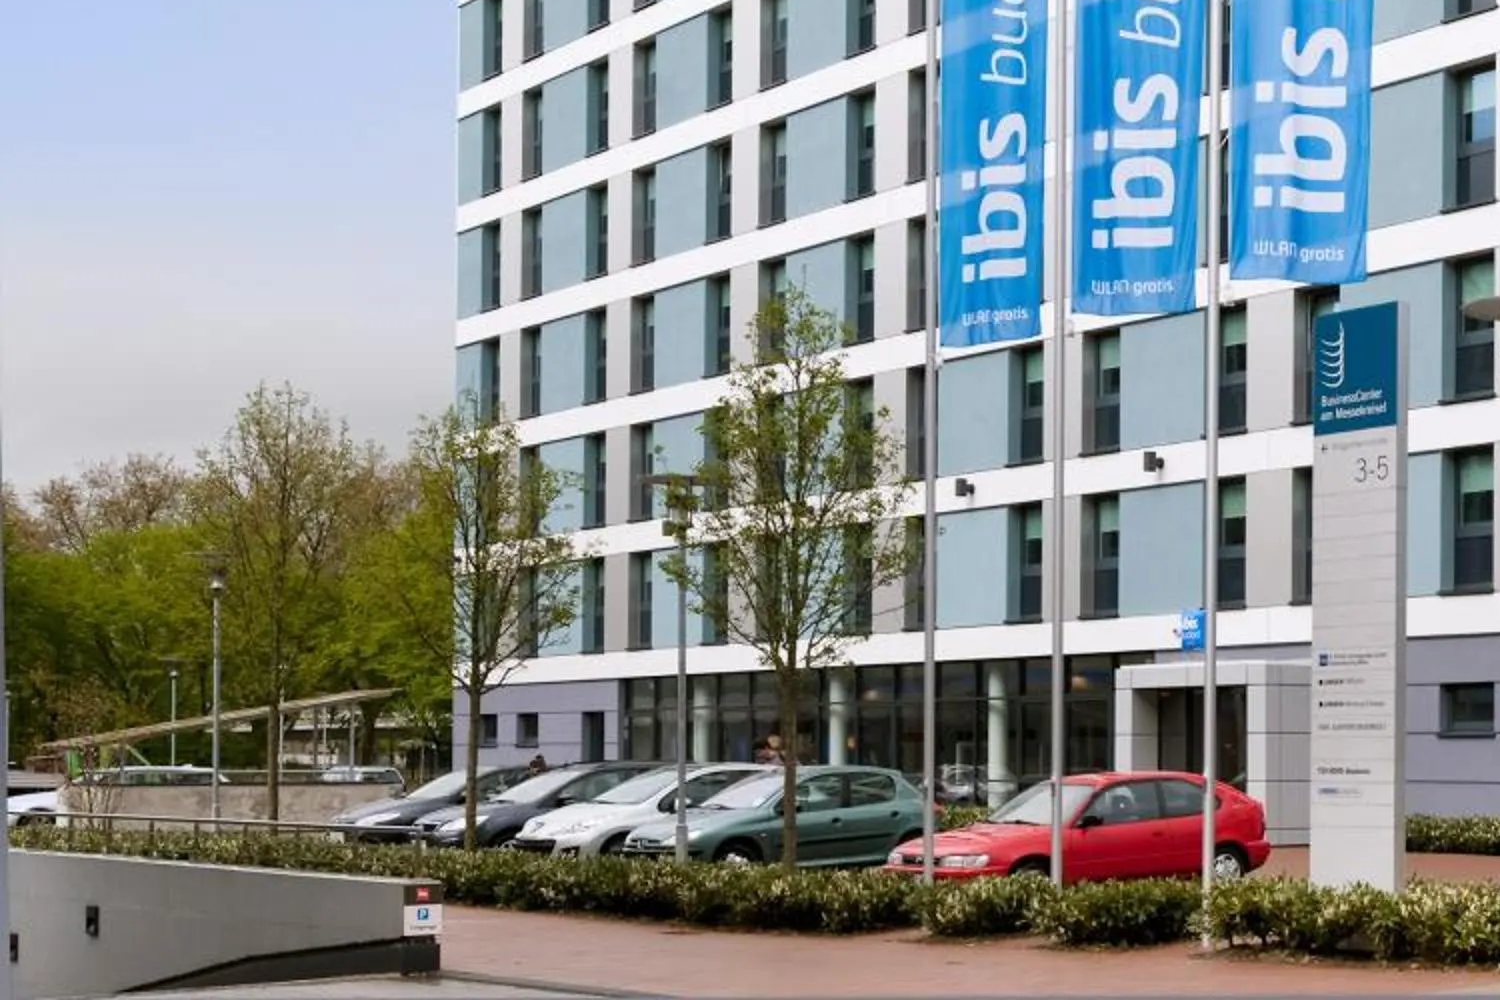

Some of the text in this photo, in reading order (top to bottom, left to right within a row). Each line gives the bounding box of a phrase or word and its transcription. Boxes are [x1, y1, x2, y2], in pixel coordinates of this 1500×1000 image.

[1091, 72, 1179, 250] ibis
[1253, 26, 1349, 213] ibis
[961, 112, 1028, 283] ibis
[1132, 277, 1175, 297] gratis
[1253, 239, 1345, 263] WLAN gratis
[1354, 455, 1390, 483] 3-5
